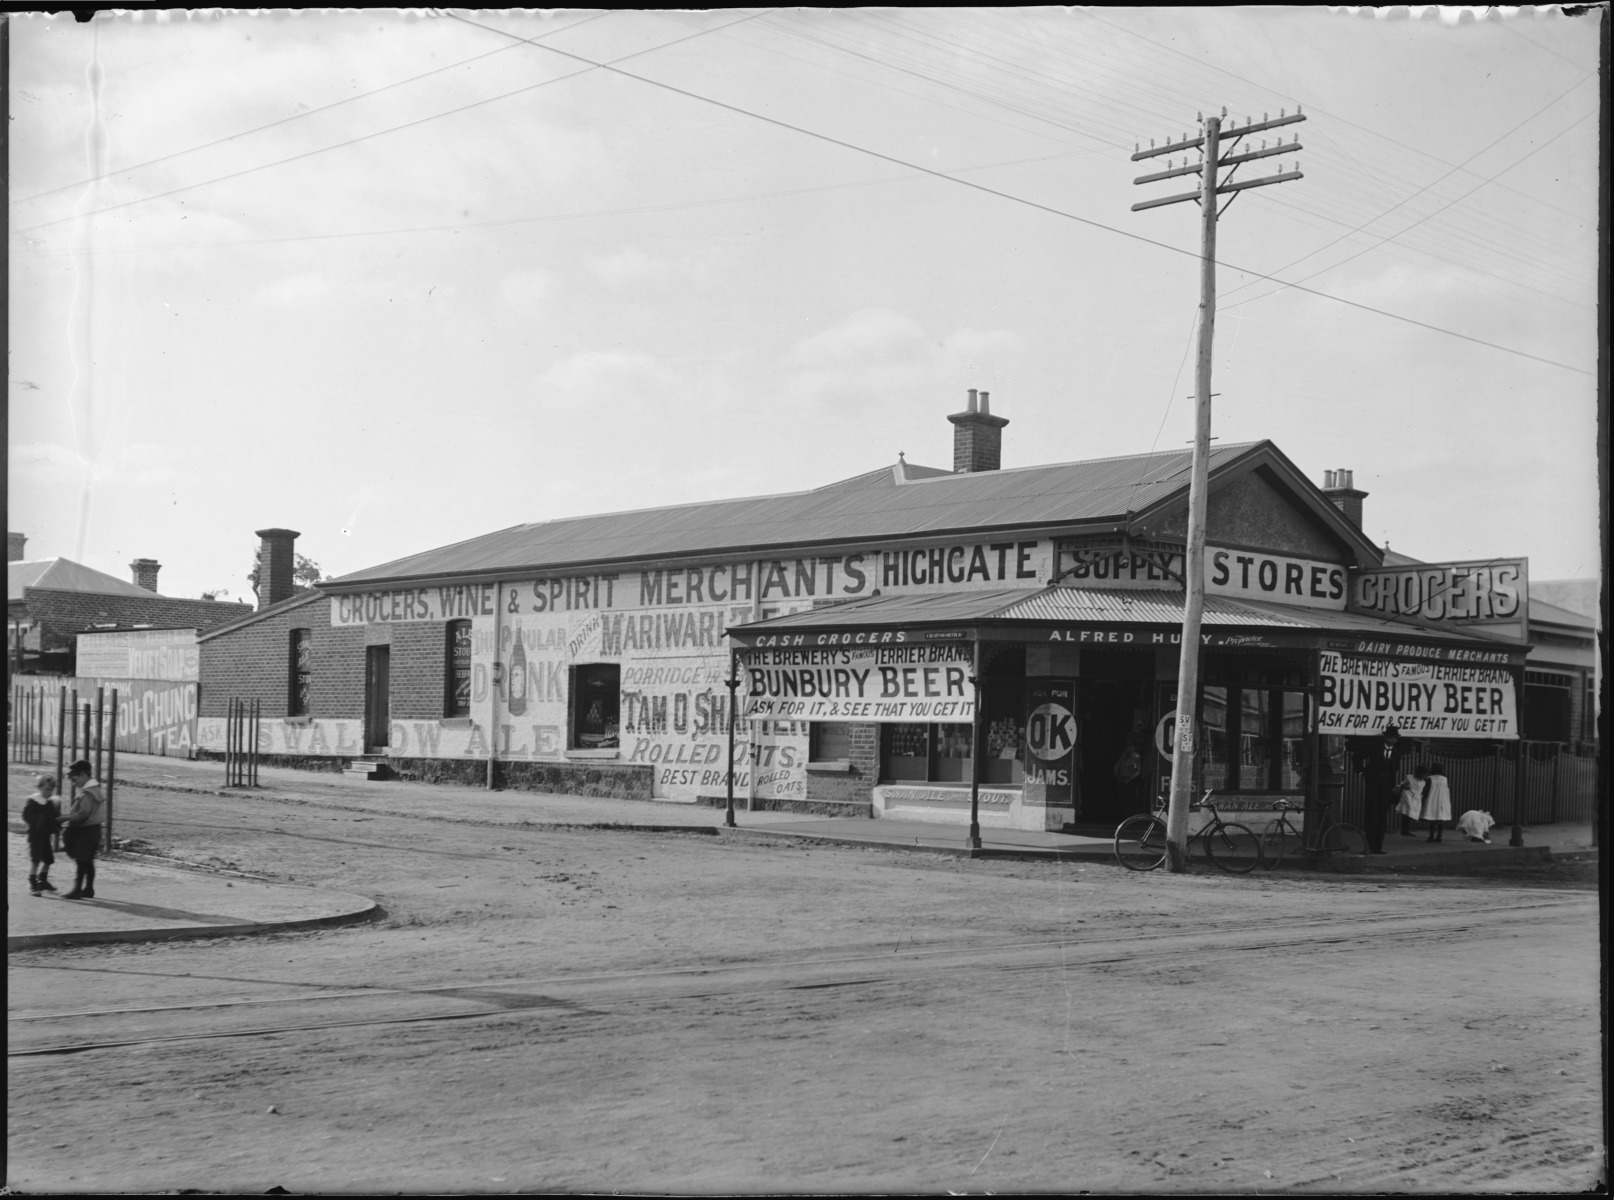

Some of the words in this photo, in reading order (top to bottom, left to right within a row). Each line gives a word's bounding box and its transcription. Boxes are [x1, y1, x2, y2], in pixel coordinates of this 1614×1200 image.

[883, 541, 1038, 587] HIGHGATE
[1073, 547, 1175, 580] SUPPLY
[1212, 551, 1344, 600] STORES
[507, 588, 520, 614] &
[532, 574, 620, 613] SPIRIT
[640, 554, 867, 606] MERCHANTS
[1358, 566, 1520, 621] GROCERS
[501, 625, 567, 652] PPULAR
[568, 616, 601, 658] DRINK
[756, 634, 805, 647] CASH
[817, 631, 907, 645] GROCERS
[1049, 630, 1134, 643] ALFRED
[1152, 632, 1224, 646] HUY.
[748, 649, 770, 665] THE
[773, 648, 851, 666] BREWERY'S
[851, 649, 875, 661] FAMOUS
[874, 646, 926, 665] TERRIER
[1358, 641, 1392, 655] DAIRY
[1396, 644, 1441, 659] PRODUCE
[1448, 649, 1509, 664] MERCHANTS
[473, 660, 564, 703] DRNK
[622, 666, 705, 685] PORRIDGE
[1320, 654, 1338, 673] THE
[1340, 655, 1400, 678] BREWERY'S
[1401, 664, 1430, 676] FAMOUS
[1429, 665, 1476, 683] TERRIER
[1476, 667, 1511, 685] BRAND
[748, 668, 871, 698] BUNBURY
[878, 666, 965, 698] BEER
[1051, 689, 1068, 698] FOR
[1319, 675, 1437, 713] BUNBURY
[1443, 682, 1504, 715] BEER
[101, 684, 195, 741] POU-CHUNG
[622, 689, 668, 735] TAM
[748, 699, 776, 715] ASK
[777, 701, 806, 716] FOR
[829, 701, 840, 716] &
[841, 701, 872, 717] SEE
[873, 701, 908, 717] THAT
[909, 701, 932, 717] YOU
[932, 701, 959, 717] GET
[958, 701, 974, 716] IT
[200, 724, 222, 742] ASK
[1030, 713, 1073, 751] OK
[1318, 710, 1345, 728] ASK
[1345, 713, 1369, 729] FOR
[1386, 716, 1395, 729] &
[1396, 715, 1418, 730] SEE
[1420, 715, 1448, 731] THAT
[1450, 717, 1470, 732] YOU
[1474, 718, 1496, 732] GET
[1497, 719, 1509, 732] IT
[153, 724, 197, 750] TEA.
[257, 721, 442, 757] SWALOW
[463, 723, 561, 760] ALE
[628, 738, 721, 765] ROLLED
[660, 768, 698, 786] BEST
[757, 769, 790, 787] ROLLED
[1027, 763, 1071, 786] JAMS.
[776, 780, 804, 794] OATS.
[885, 789, 917, 800] SWAN
[920, 790, 945, 801] ALE
[1241, 802, 1259, 810] ALE
